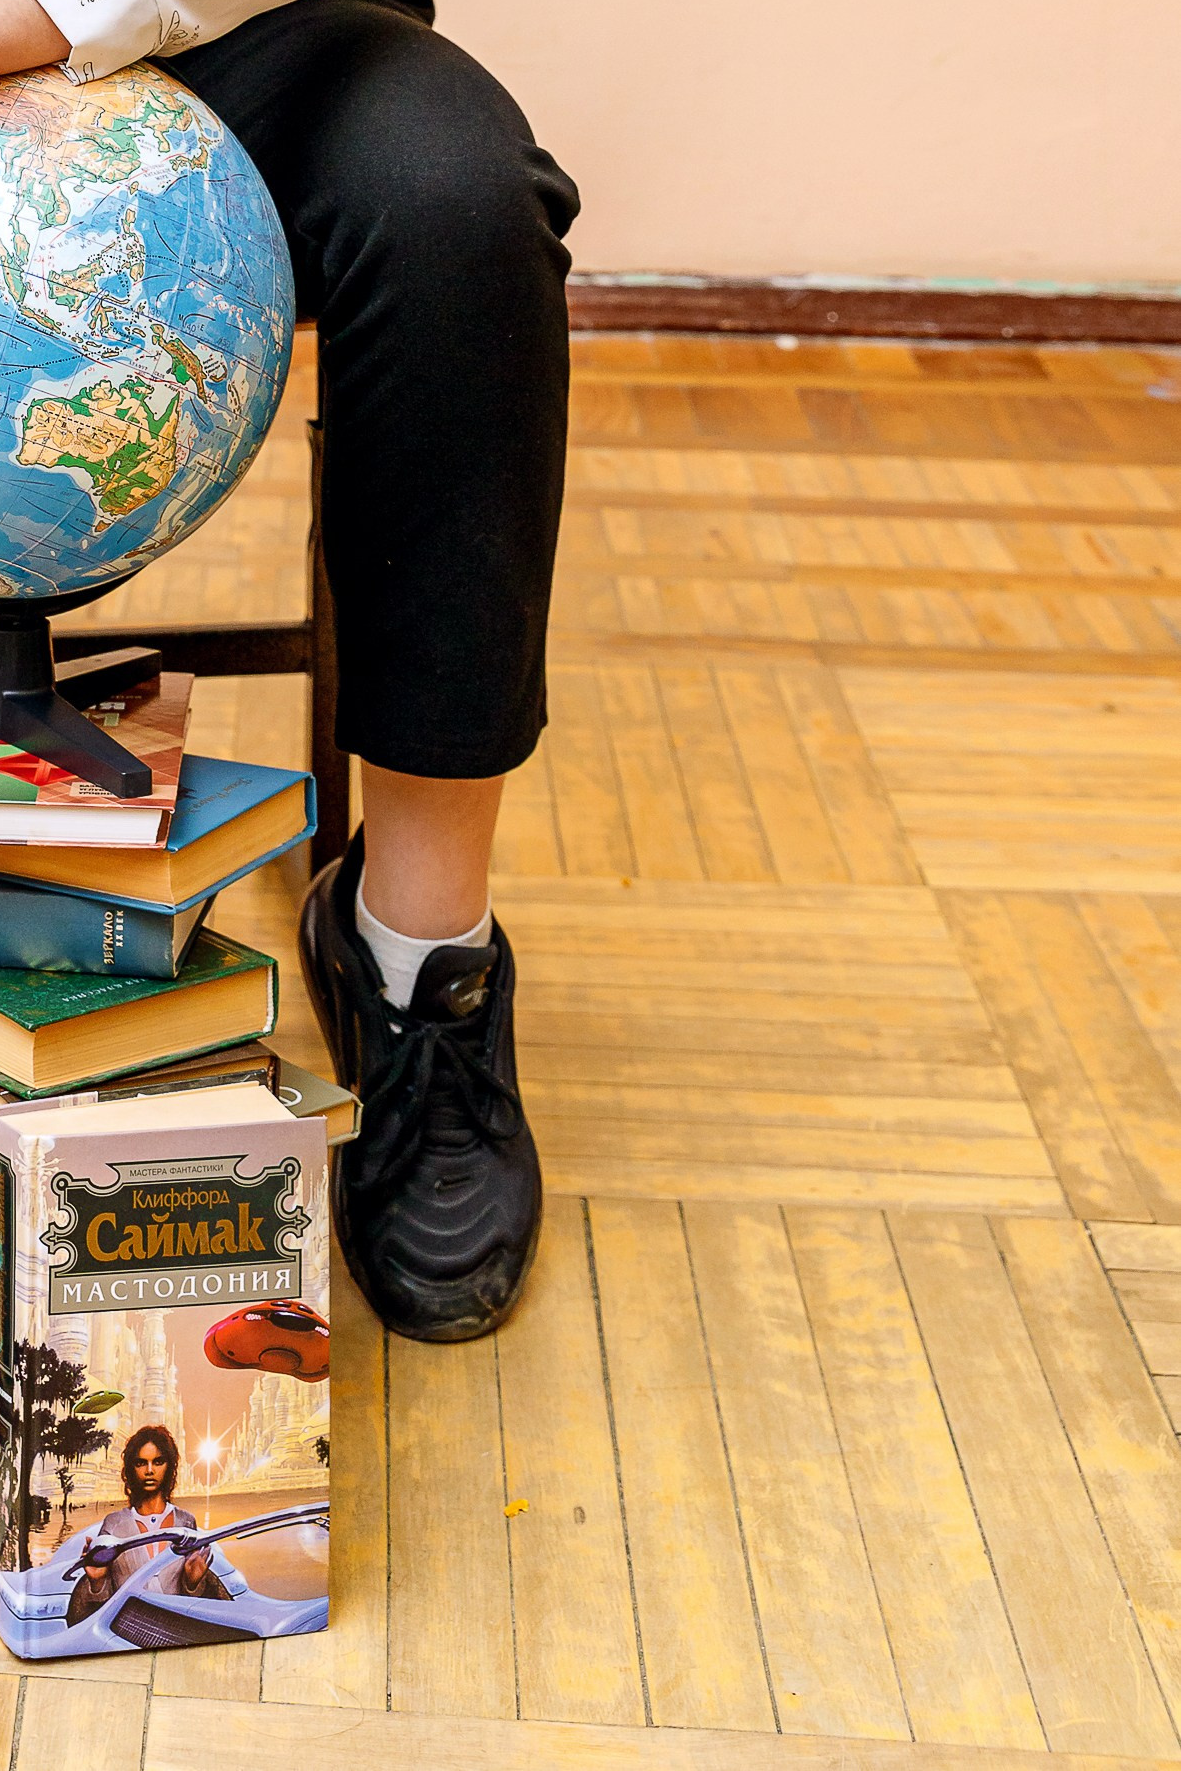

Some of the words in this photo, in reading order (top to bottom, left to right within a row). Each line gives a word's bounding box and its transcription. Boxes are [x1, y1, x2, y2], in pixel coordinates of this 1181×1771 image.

[115, 909, 124, 931] ВЕК
[103, 911, 115, 965] ЗЕРКАЛО
[129, 1166, 168, 1178] МАСТЕРА
[169, 1163, 225, 1175] ФАНТАСТИКИ
[131, 1186, 231, 1211] Клиффорд
[86, 1203, 266, 1263] Саймак
[61, 1267, 294, 1305] МАСТОДОНИЯ
